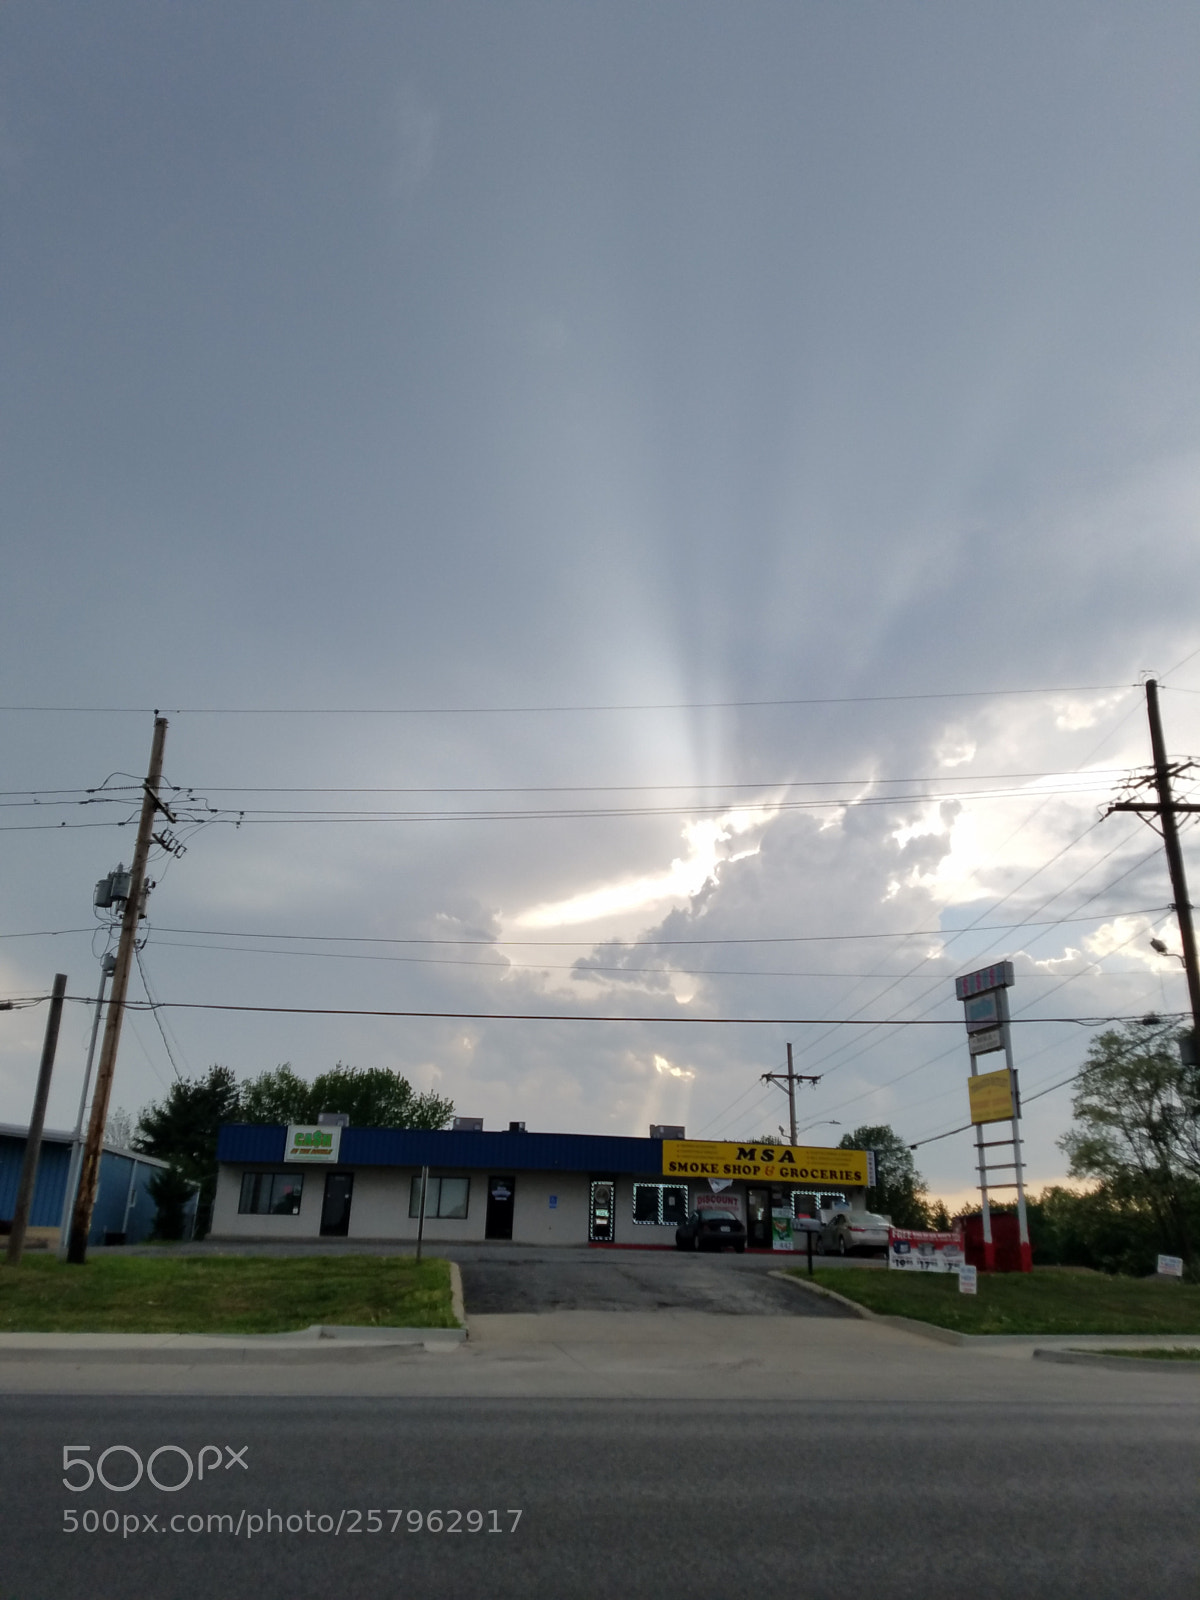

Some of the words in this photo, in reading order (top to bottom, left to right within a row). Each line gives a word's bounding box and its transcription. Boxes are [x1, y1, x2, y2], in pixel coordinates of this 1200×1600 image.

[736, 1147, 795, 1164] MSA
[669, 1162, 719, 1174] SMOKE
[723, 1164, 761, 1176] SHOP
[764, 1166, 775, 1177] &
[780, 1167, 862, 1181] GROCERIES
[697, 1195, 738, 1205] DISCOUNT
[892, 1228, 913, 1240] FREE
